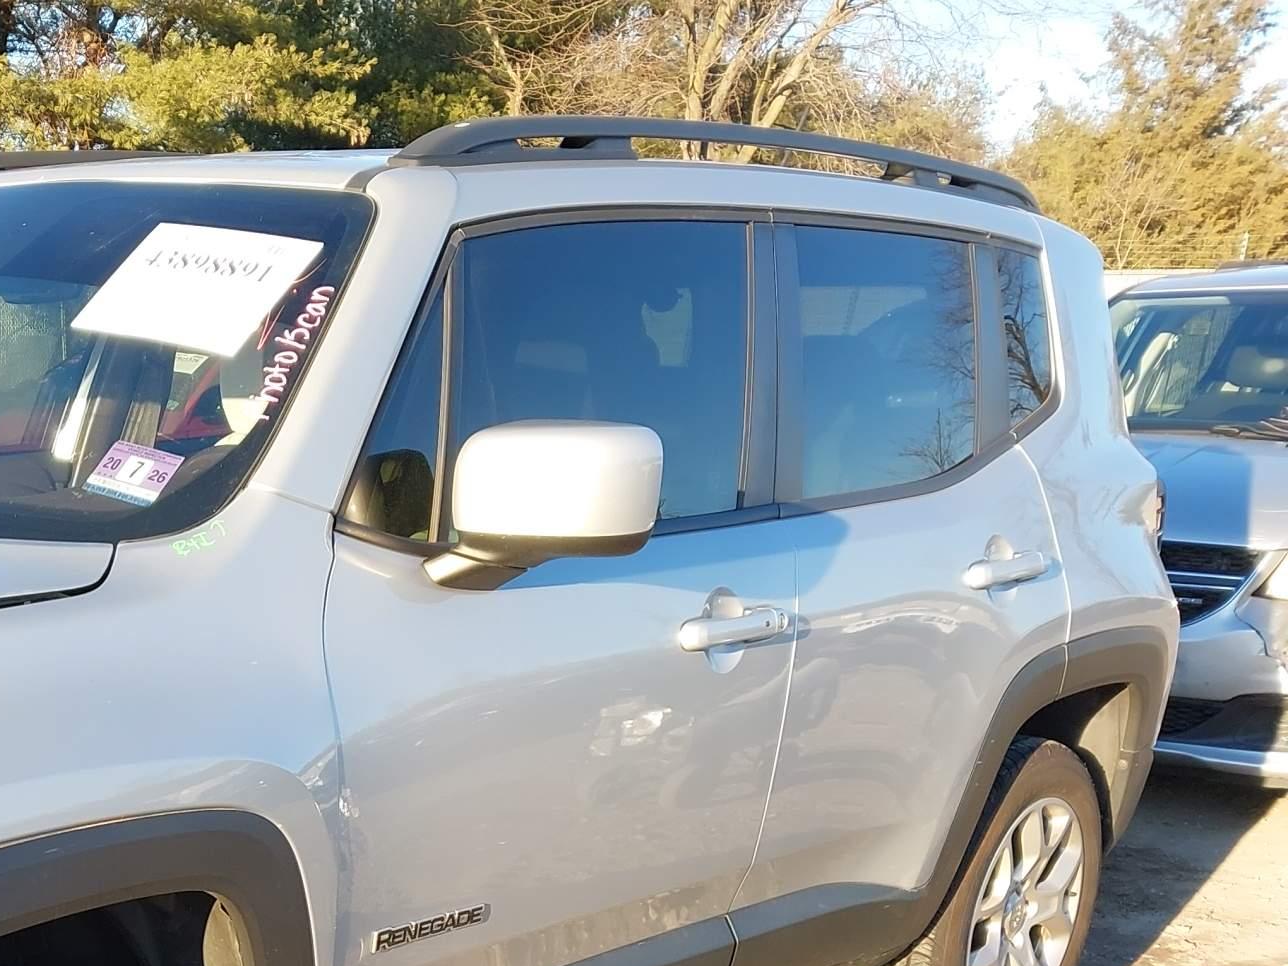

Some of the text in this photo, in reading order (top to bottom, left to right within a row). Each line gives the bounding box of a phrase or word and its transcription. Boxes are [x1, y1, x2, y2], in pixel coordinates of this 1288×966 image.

[102, 456, 169, 484] 20 7 26
[374, 905, 484, 953] RENEGADE
